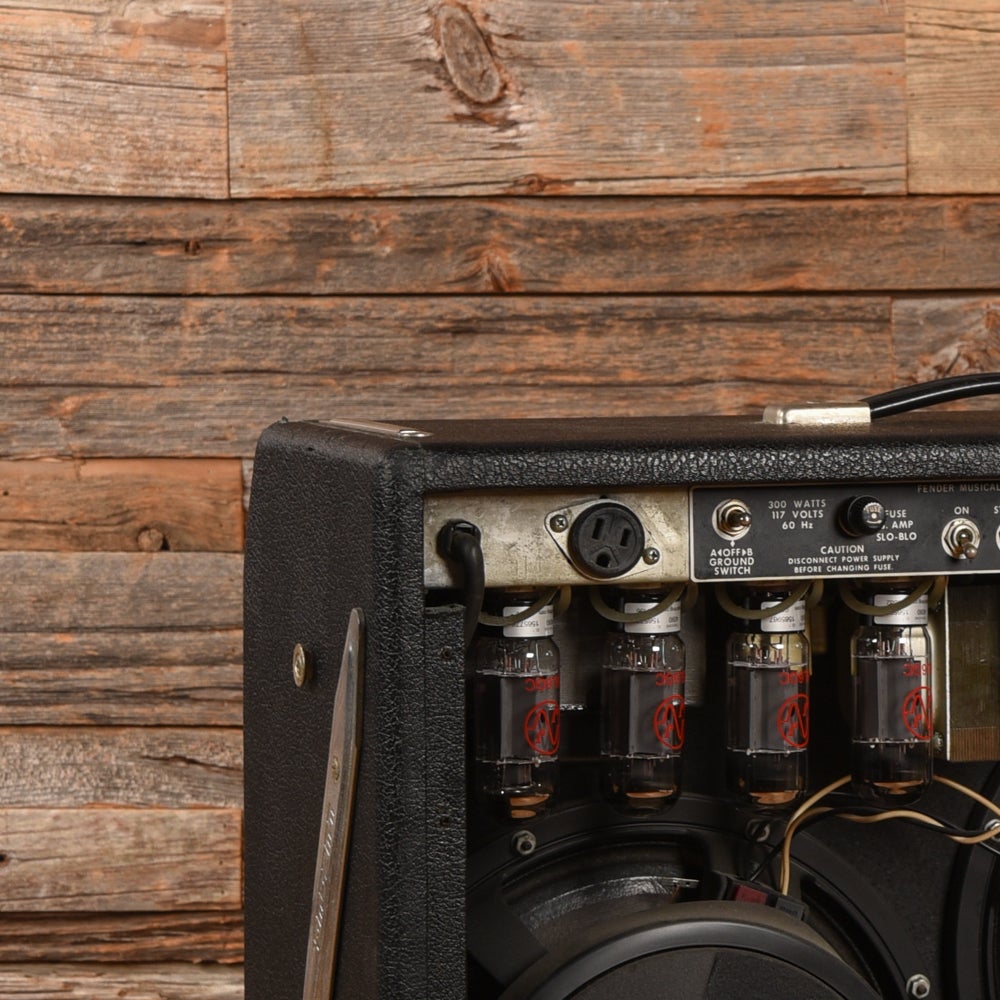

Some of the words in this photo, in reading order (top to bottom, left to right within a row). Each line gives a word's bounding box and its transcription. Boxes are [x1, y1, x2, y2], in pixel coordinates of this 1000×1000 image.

[918, 484, 954, 493] FENDER
[960, 483, 1000, 492] MUSICAL
[768, 500, 787, 509] 300
[794, 499, 826, 508] WATTS
[772, 511, 786, 519] 117
[792, 510, 824, 519] VOLTS
[782, 521, 795, 530] 60
[801, 521, 813, 529] Hz
[892, 520, 914, 529] AMP
[876, 532, 917, 541] SLO-BLO
[820, 545, 864, 554] CAUTION
[710, 557, 754, 566] GROUND
[714, 566, 750, 575] SWITCH
[827, 564, 870, 572] CHANGING
